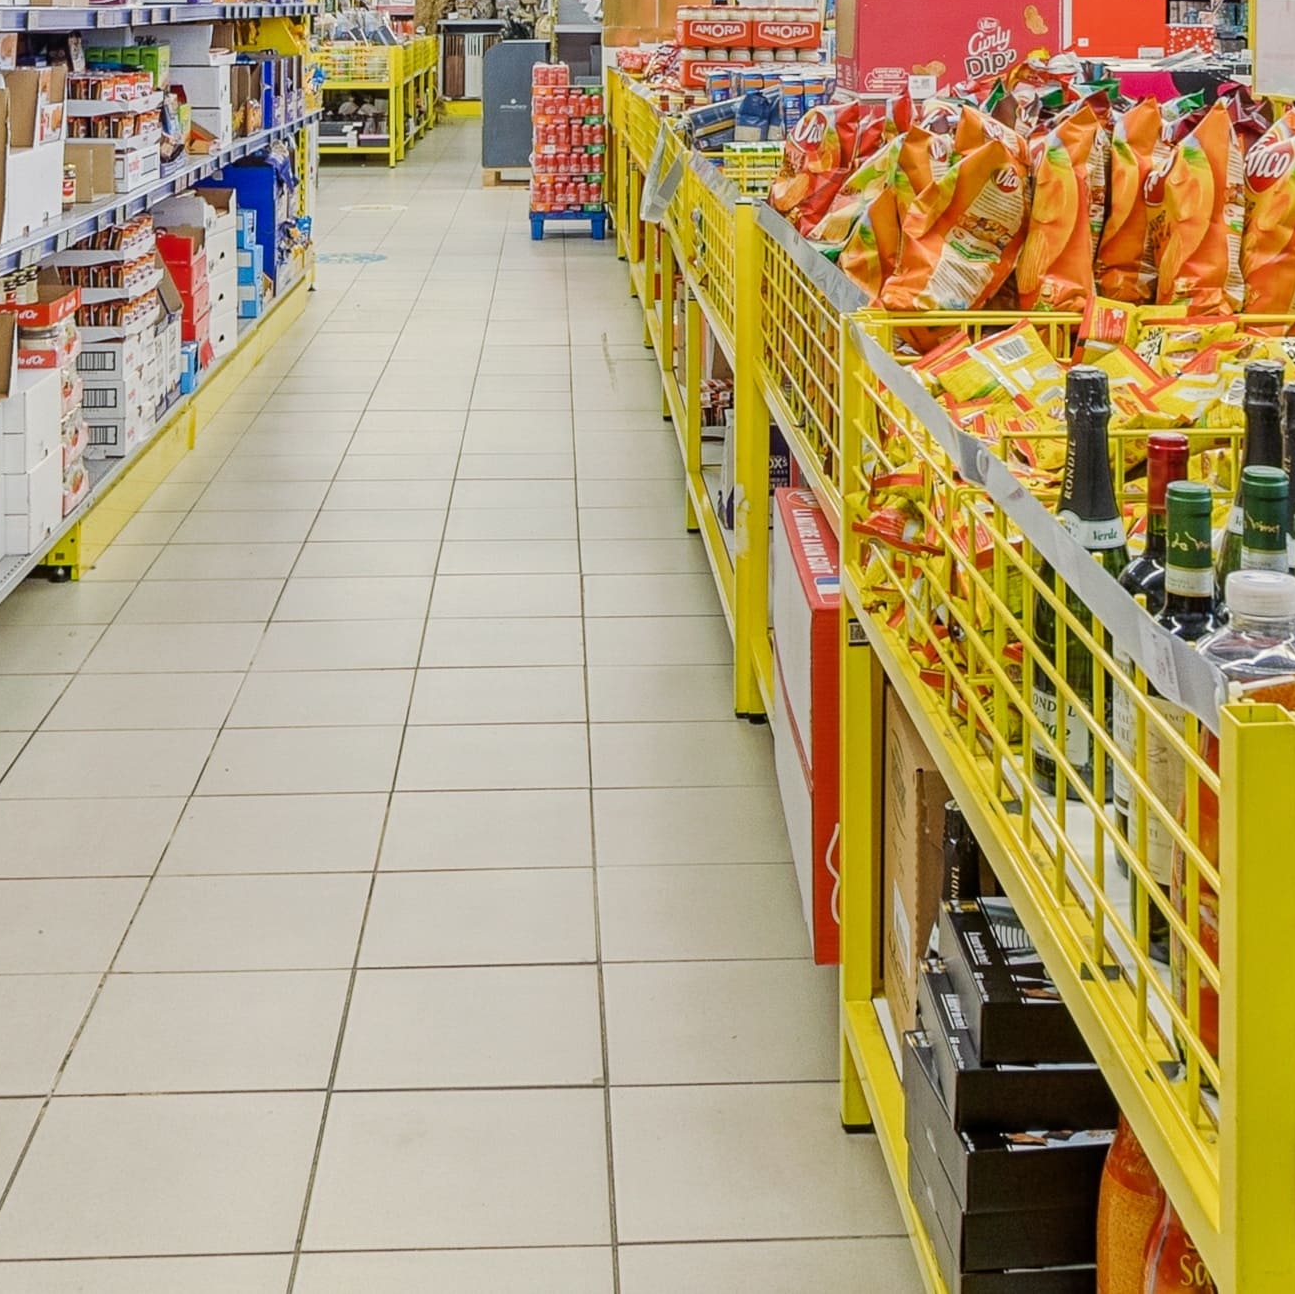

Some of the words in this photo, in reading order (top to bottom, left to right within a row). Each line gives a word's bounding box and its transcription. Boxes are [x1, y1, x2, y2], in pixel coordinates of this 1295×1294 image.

[695, 23, 746, 37] AMORA
[761, 23, 814, 37] AMORA
[968, 26, 1011, 57] Curly
[1064, 438, 1077, 500] RONDEL
